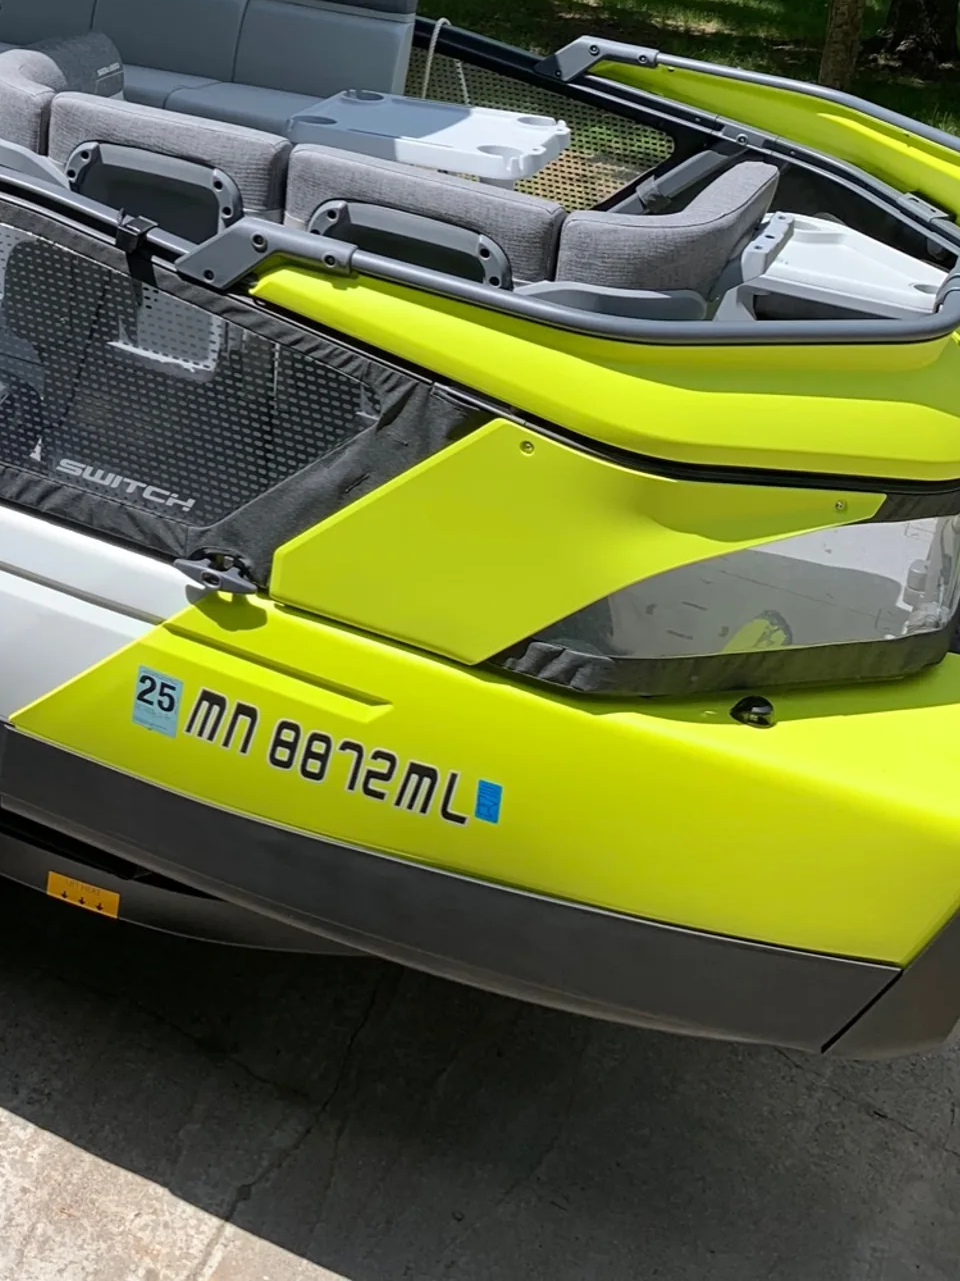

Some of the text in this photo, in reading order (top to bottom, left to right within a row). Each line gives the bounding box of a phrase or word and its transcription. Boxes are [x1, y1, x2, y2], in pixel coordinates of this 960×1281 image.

[56, 458, 196, 512] SWITCH
[136, 674, 177, 713] 25
[269, 720, 468, 825] 8872ML
